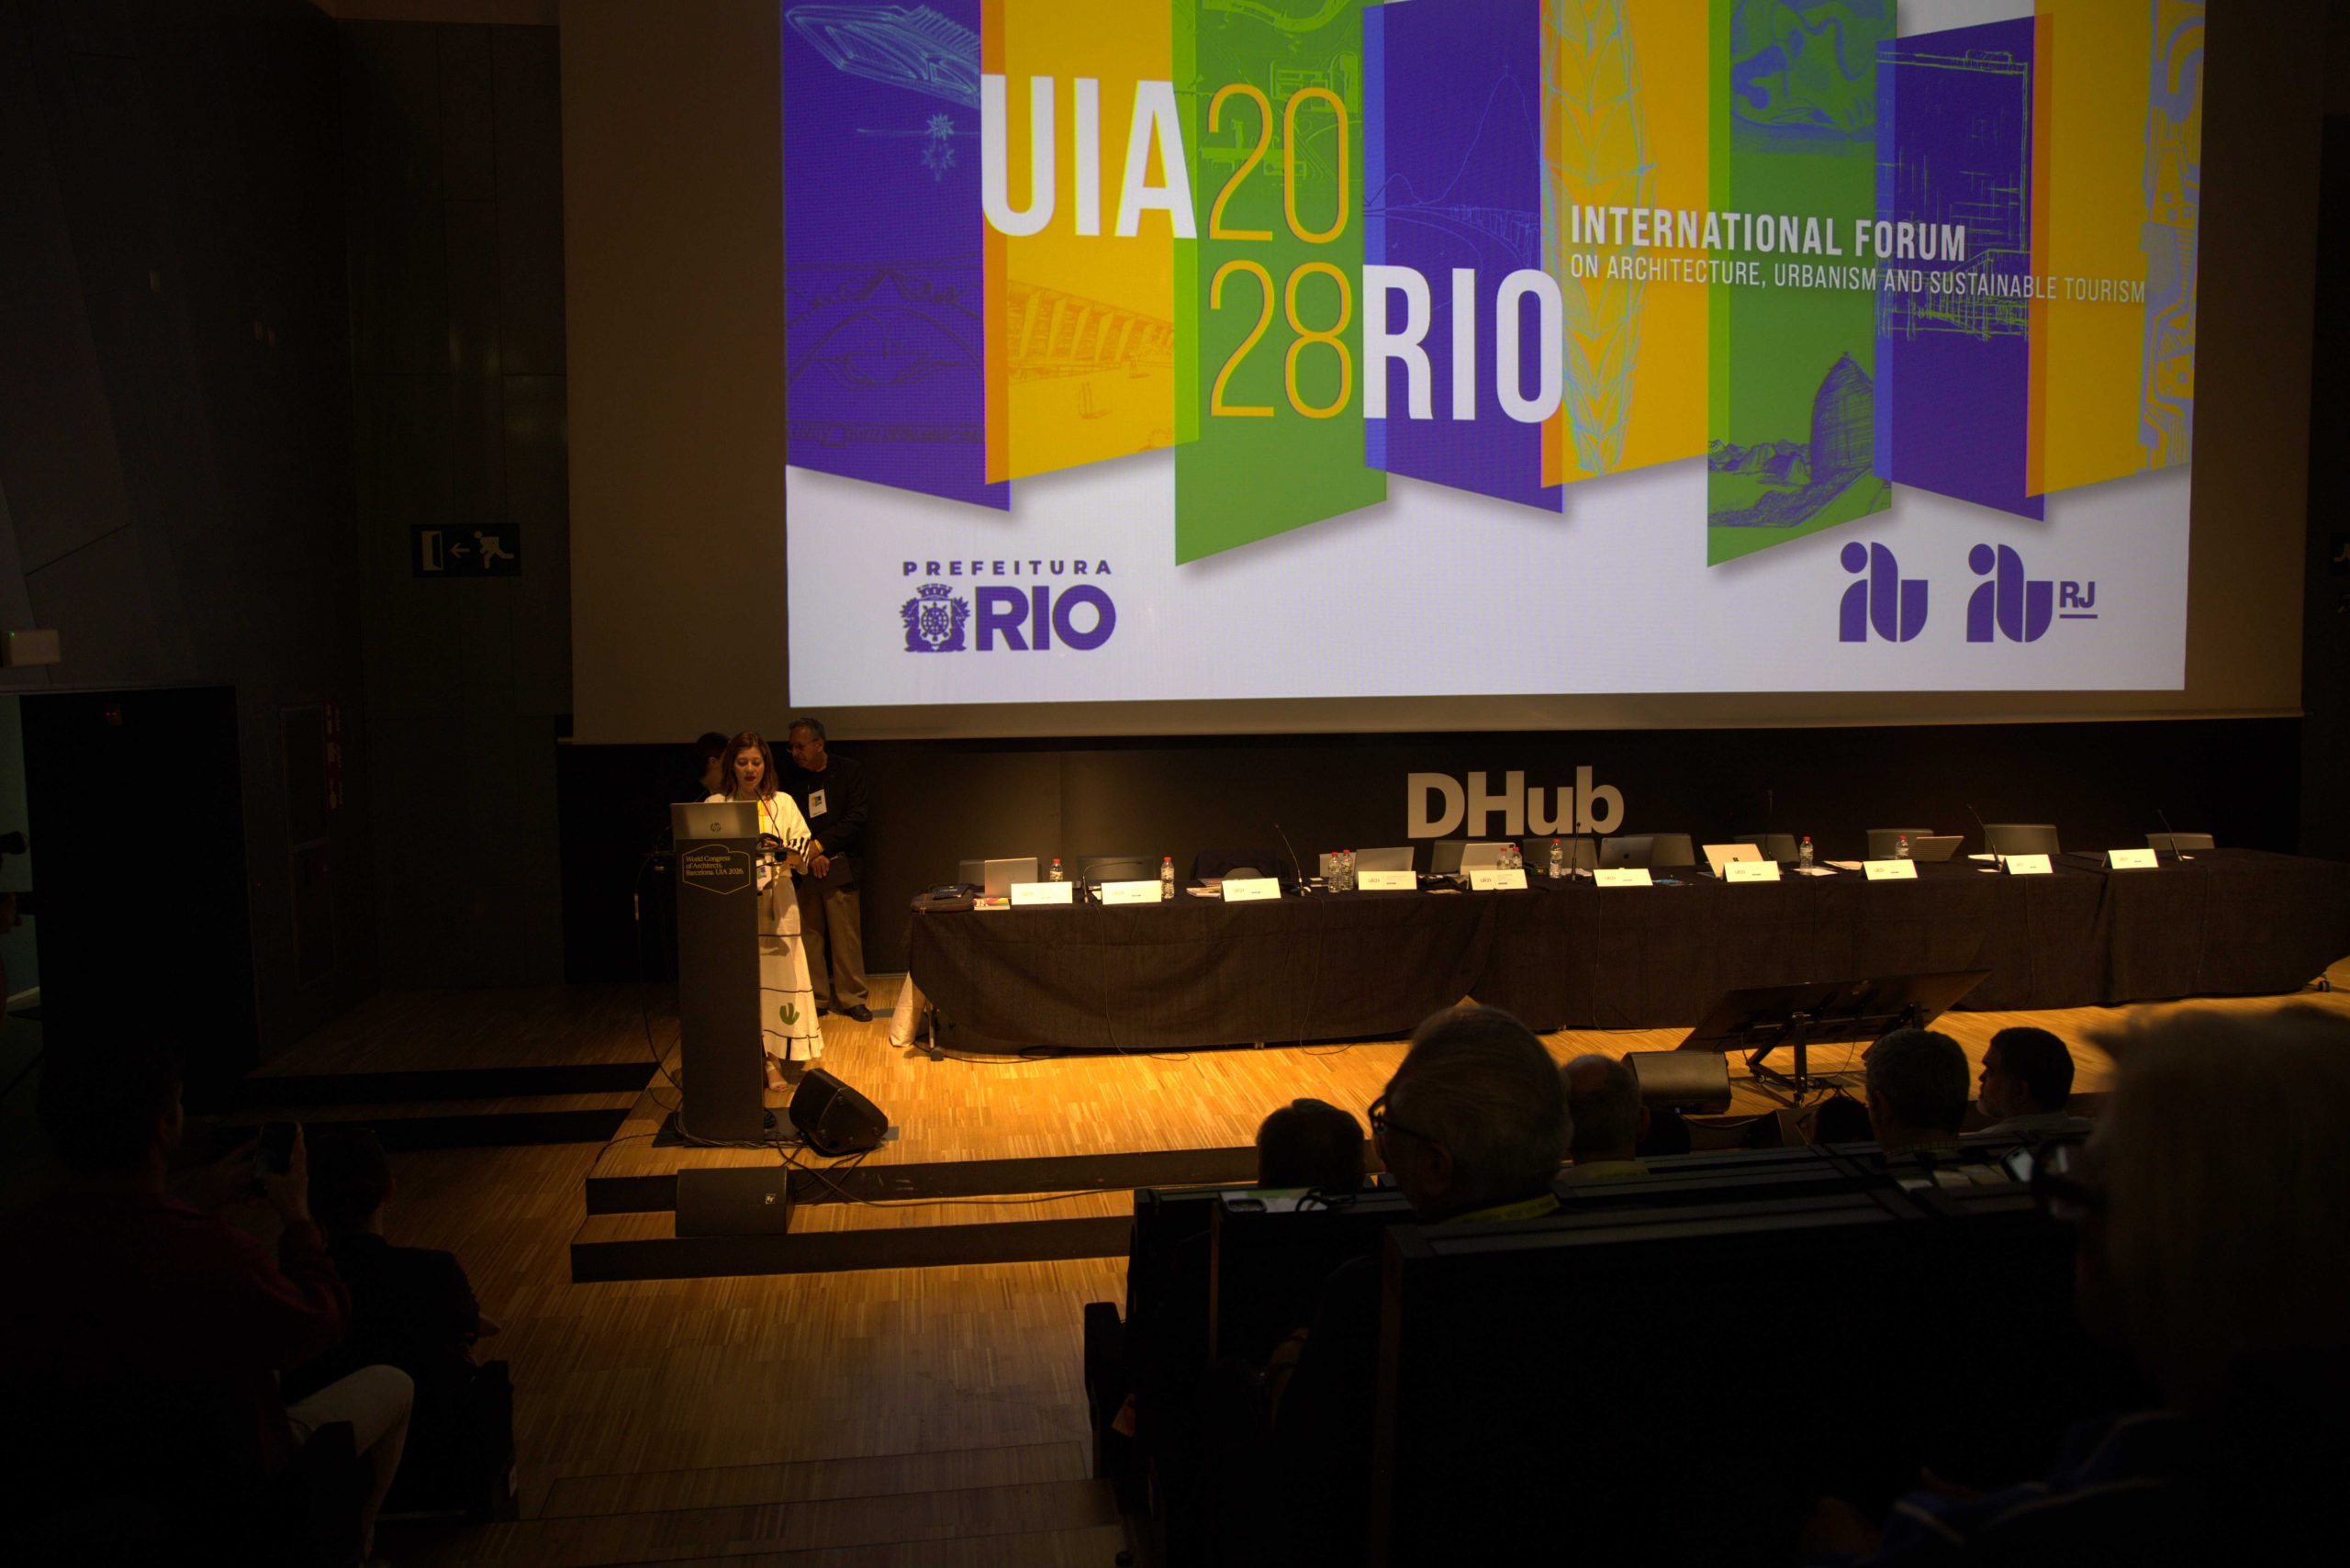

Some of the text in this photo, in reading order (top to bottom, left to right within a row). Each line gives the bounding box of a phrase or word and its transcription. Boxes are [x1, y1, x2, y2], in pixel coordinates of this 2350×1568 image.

[980, 73, 1197, 239] UIA
[1207, 84, 1348, 243] 20
[1571, 205, 1965, 262] INTERNATIONAL FORUM
[1571, 253, 2146, 304] ON ARCHITECTURE, URBANISM AND SUSTAINABLE TOURISM
[1208, 259, 1351, 419] 28
[1362, 264, 1562, 422] RIO
[902, 560, 1112, 576] PREFEITURA
[2059, 581, 2095, 608] RJ
[975, 584, 1116, 651] RIO
[1407, 766, 1624, 838] DHub
